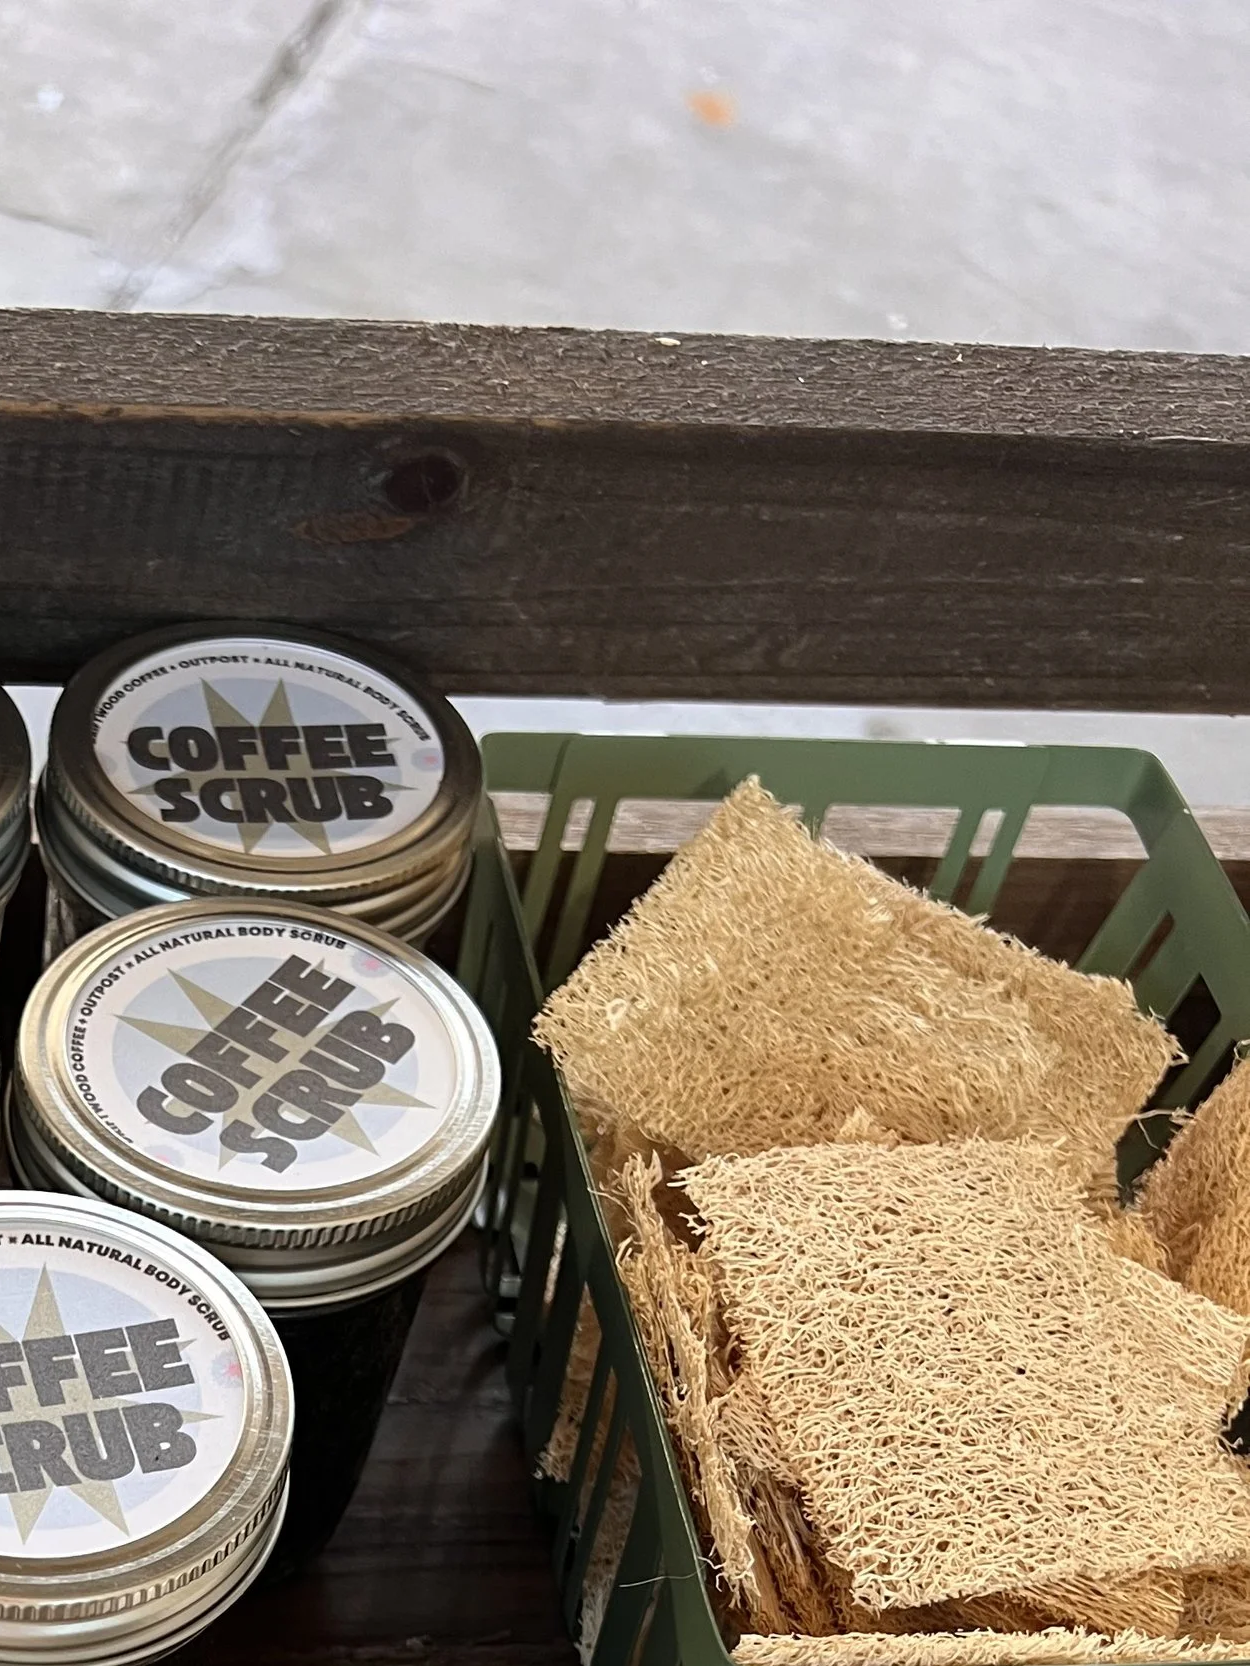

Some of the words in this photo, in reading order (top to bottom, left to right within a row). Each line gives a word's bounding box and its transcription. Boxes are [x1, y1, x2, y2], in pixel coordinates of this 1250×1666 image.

[123, 666, 169, 693] COFFEE
[178, 655, 249, 669] OUTPOST
[265, 657, 291, 668] ALL
[294, 661, 361, 689] NATURAL
[363, 686, 399, 710] BODY
[127, 723, 398, 772] COFFEE
[153, 776, 395, 823] SCRUB
[70, 1026, 87, 1075] COFFEE
[80, 966, 126, 1017] OUTPOST
[133, 945, 161, 964] ALL
[159, 927, 235, 952] NATURAL
[237, 926, 286, 938] BODY
[289, 929, 348, 951] SCRUB
[137, 953, 358, 1136] COFFEE
[219, 1010, 416, 1174] SCRUB
[21, 1233, 54, 1247] ALL
[58, 1236, 142, 1270] NATURAL
[143, 1263, 193, 1297] BODY
[187, 1294, 232, 1341] SCRUB
